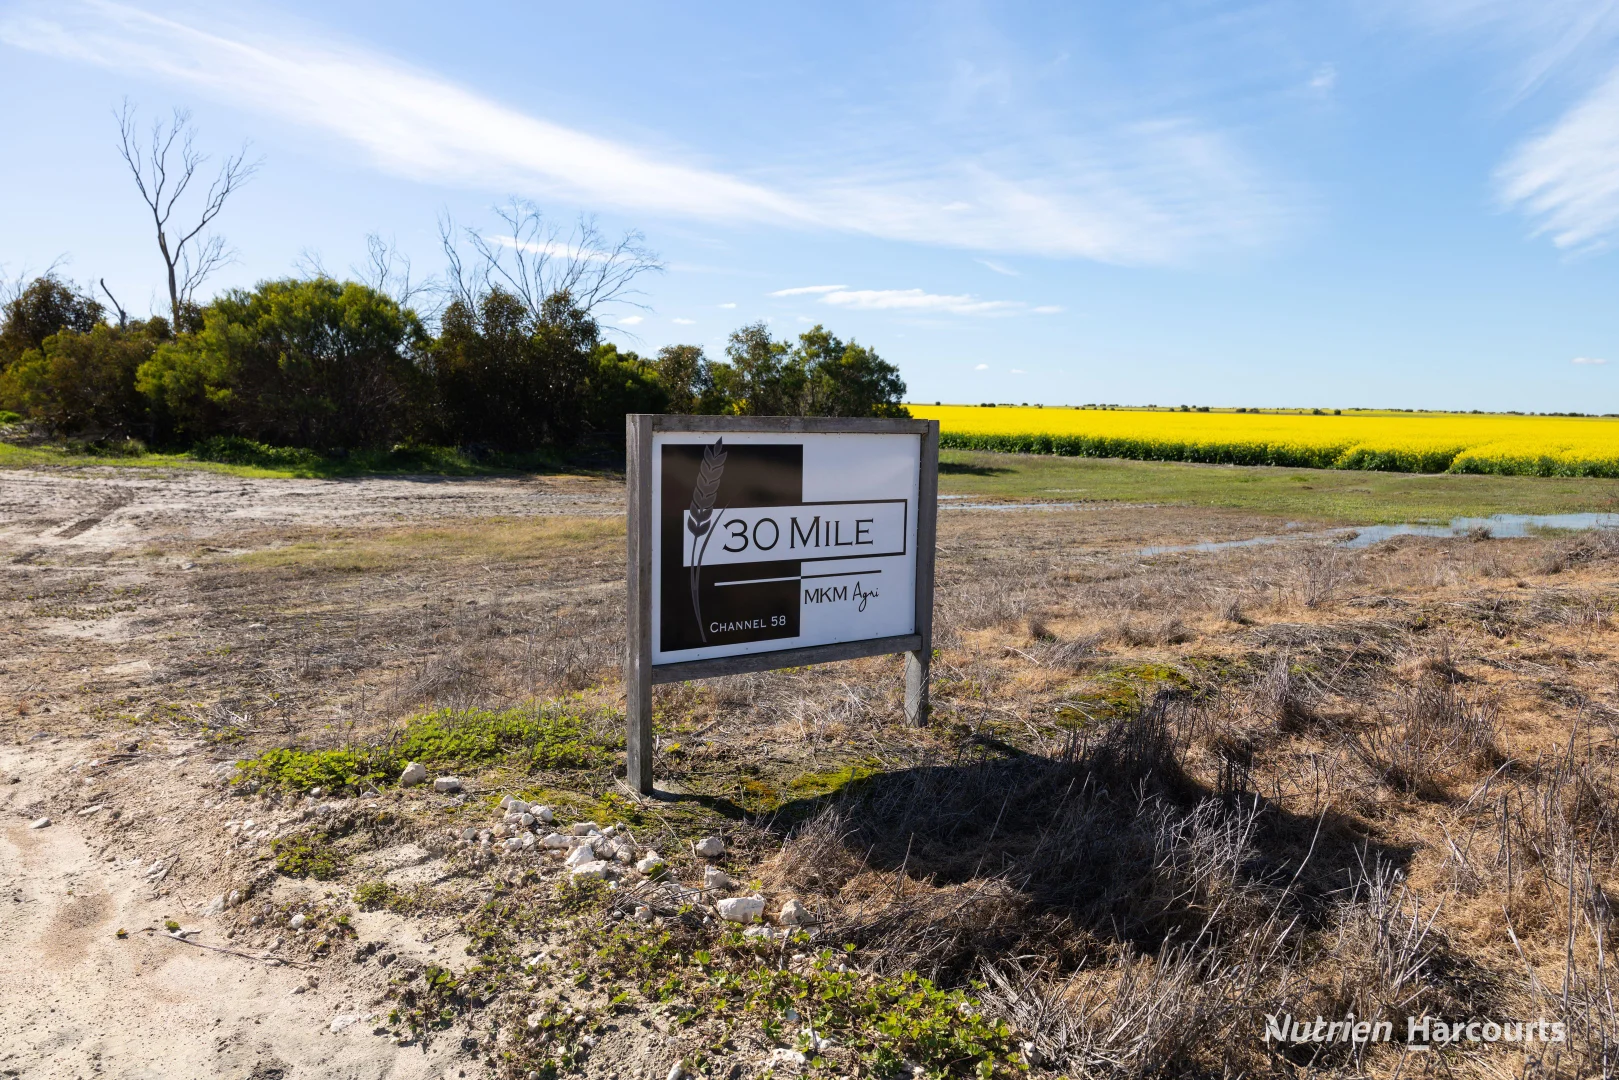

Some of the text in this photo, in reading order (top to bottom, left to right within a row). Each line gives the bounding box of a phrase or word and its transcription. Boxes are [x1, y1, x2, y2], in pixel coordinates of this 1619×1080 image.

[722, 515, 874, 553] 30 MILE
[804, 580, 879, 612] MKM Agri
[709, 615, 787, 633] CHANNEL 58
